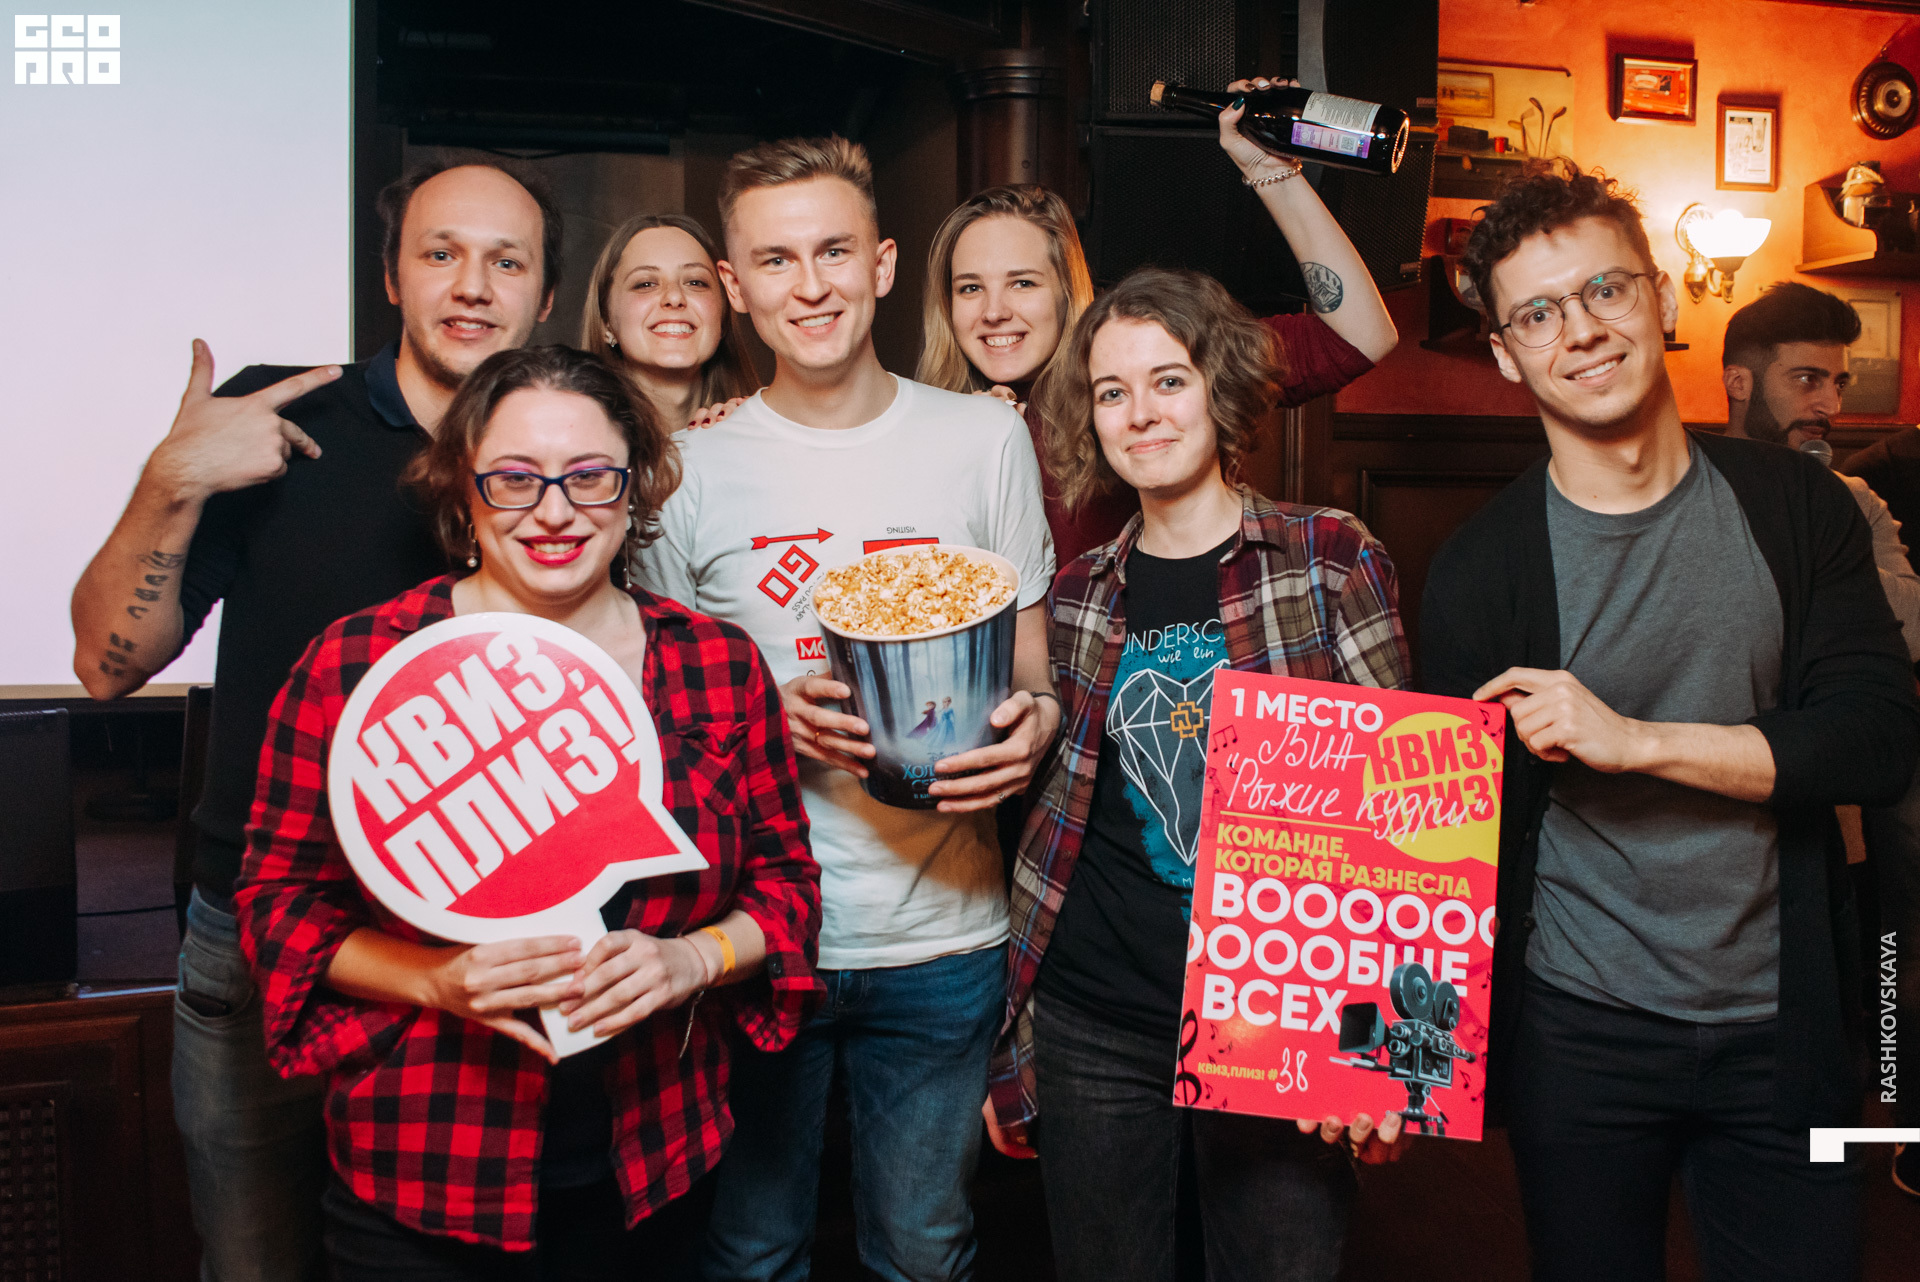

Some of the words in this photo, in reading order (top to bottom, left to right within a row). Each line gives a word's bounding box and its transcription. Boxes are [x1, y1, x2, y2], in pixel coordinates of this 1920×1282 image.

[886, 526, 917, 534] VISITING
[757, 544, 820, 608] GO
[796, 603, 811, 622] LARY
[800, 639, 826, 658] MO
[1157, 646, 1181, 663] wie
[1193, 642, 1214, 659] ein
[353, 631, 586, 823] КВИЗ,
[1231, 688, 1246, 716] 1
[1256, 690, 1384, 733] МЕСТО
[902, 763, 936, 780] ХОЛ
[1377, 723, 1497, 785] КВИЗ,
[384, 685, 641, 908] ПЛИЗ!
[1217, 823, 1350, 862] КОМАНДЕ,
[1215, 848, 1333, 882] КОТОРАЯ
[1340, 863, 1472, 898] РАЗНЕСЛА
[1201, 973, 1348, 1034] ВСЕХ
